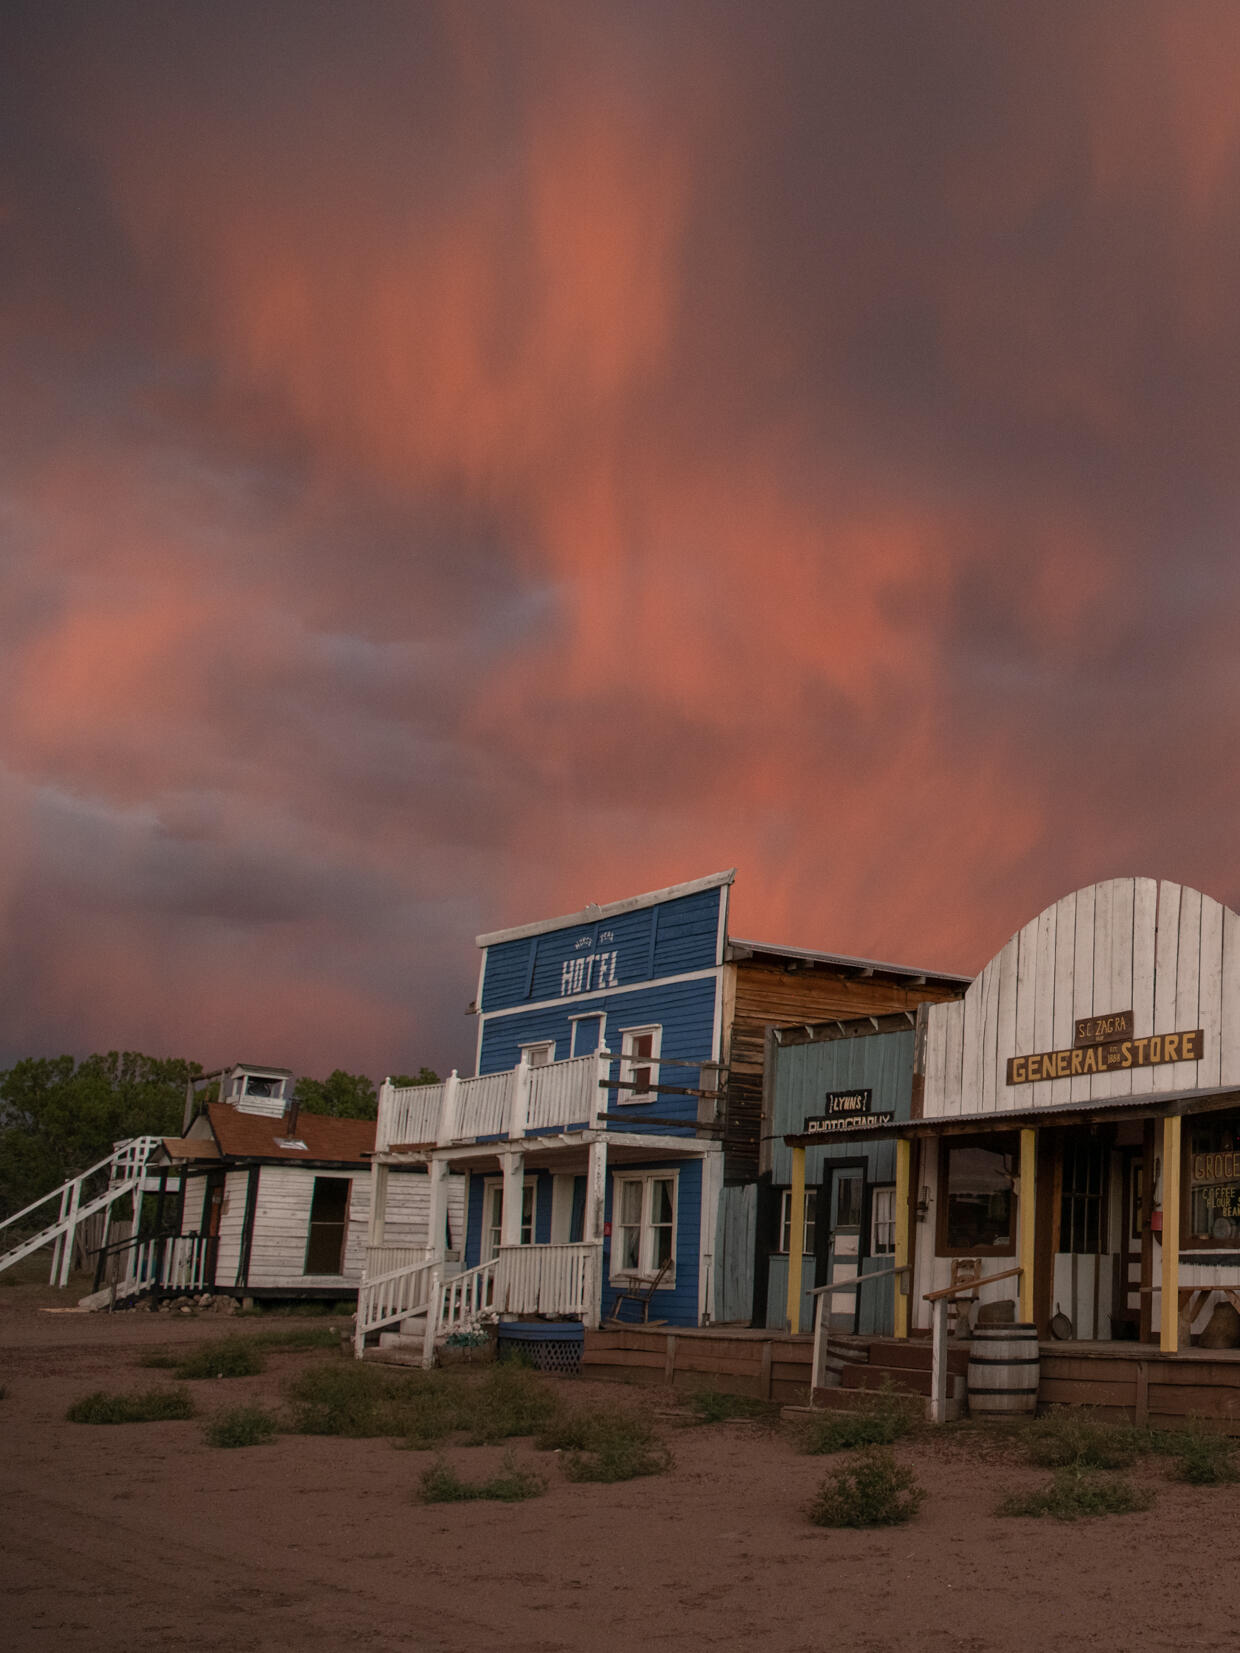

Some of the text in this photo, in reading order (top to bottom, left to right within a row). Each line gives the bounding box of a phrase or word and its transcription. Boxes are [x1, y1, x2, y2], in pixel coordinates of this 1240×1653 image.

[561, 951, 618, 996] HOTEL
[1012, 1032, 1196, 1083] GENERAL STORE
[1202, 1187, 1236, 1199] COFFEE
[1206, 1198, 1230, 1208] FLOUR
